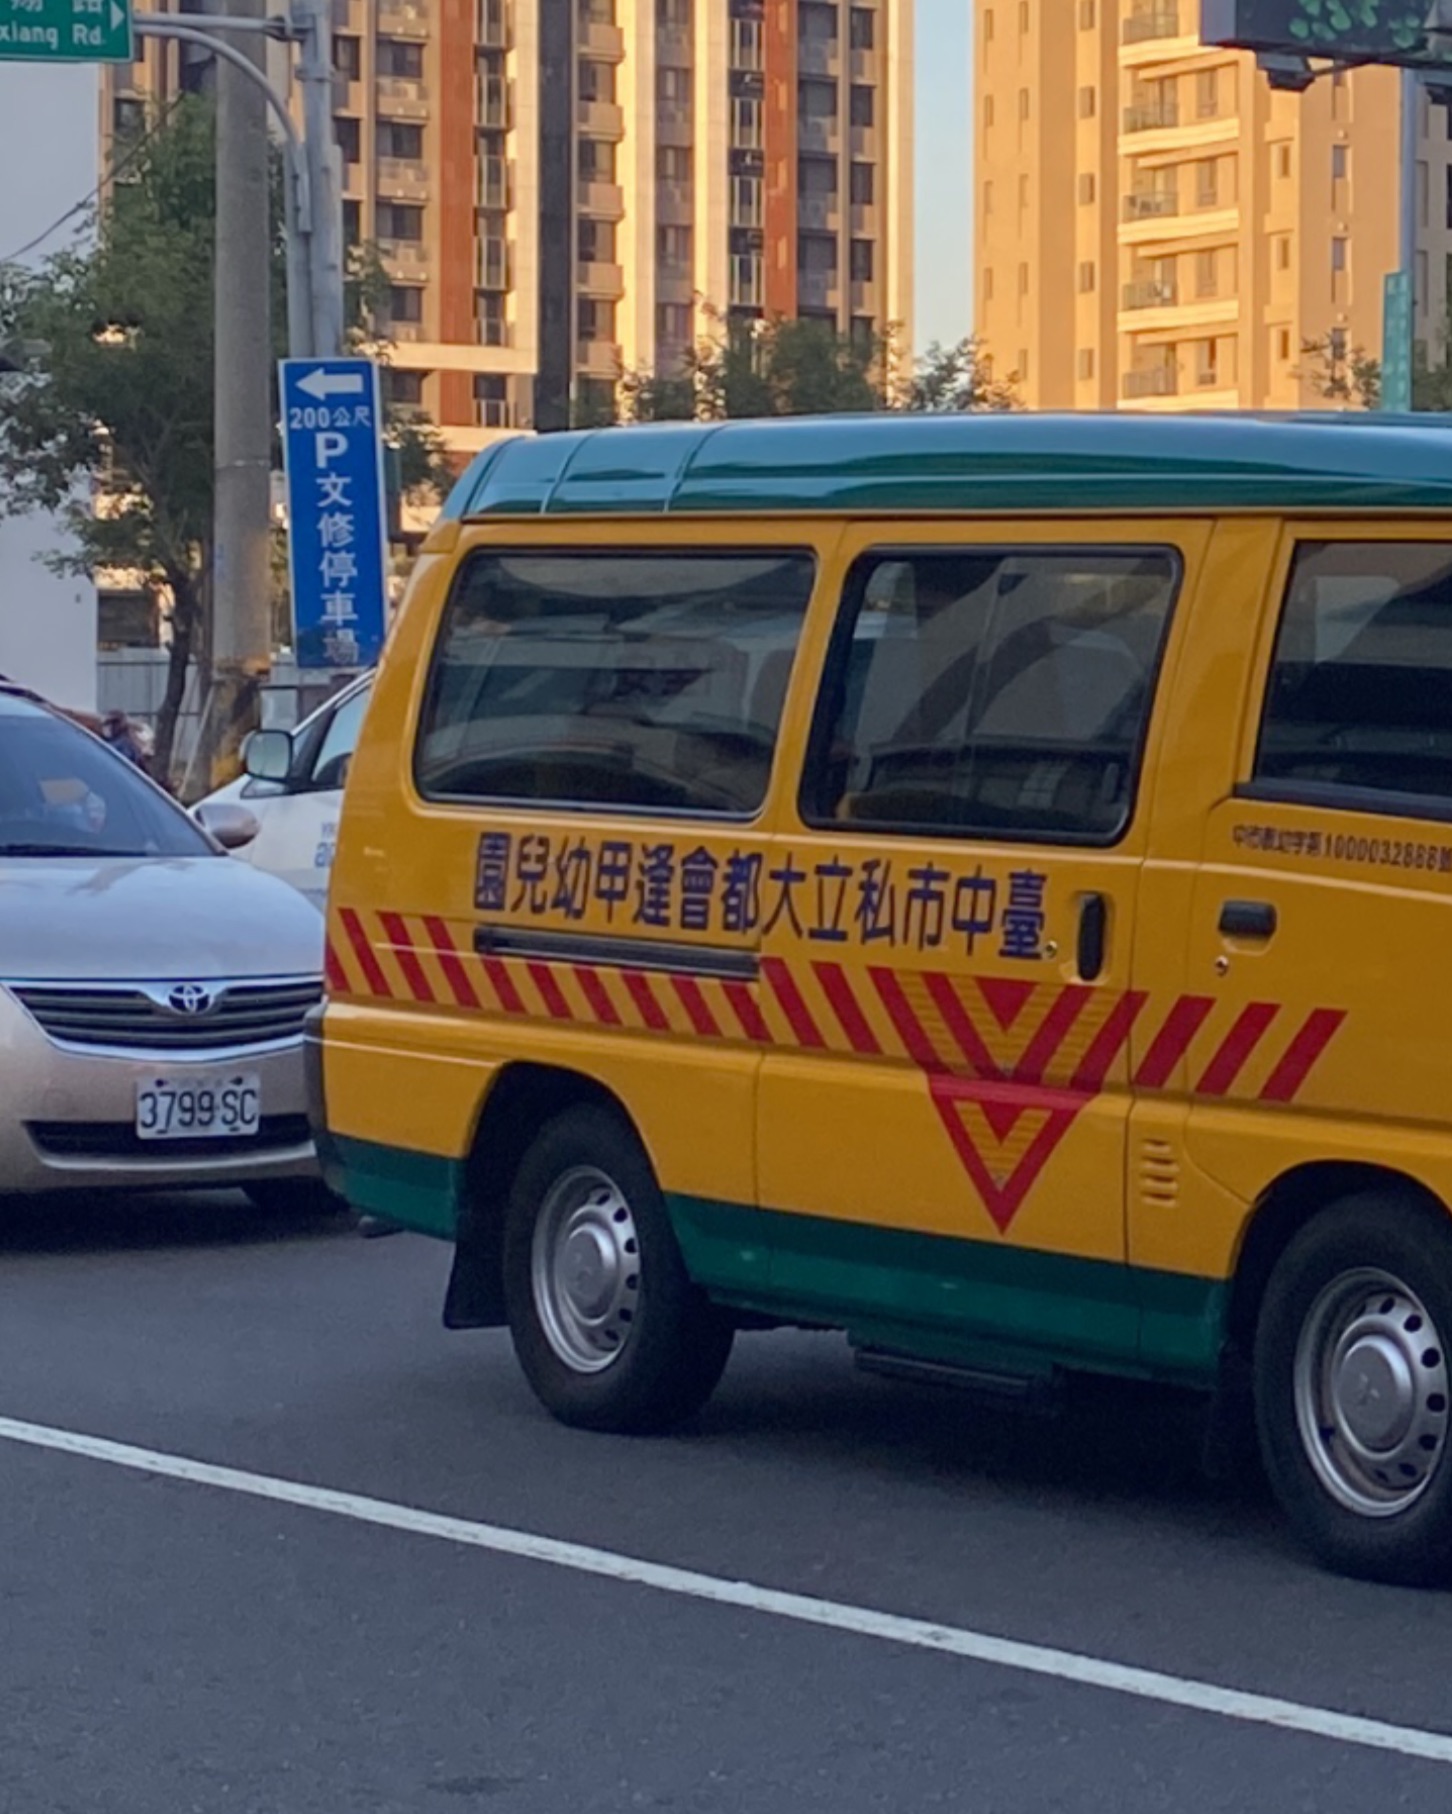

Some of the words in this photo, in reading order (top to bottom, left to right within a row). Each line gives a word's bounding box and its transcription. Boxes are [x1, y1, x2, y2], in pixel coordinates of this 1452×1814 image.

[290, 406, 371, 430] 200公尺
[315, 432, 348, 469] P
[316, 472, 359, 663] 文修停車場
